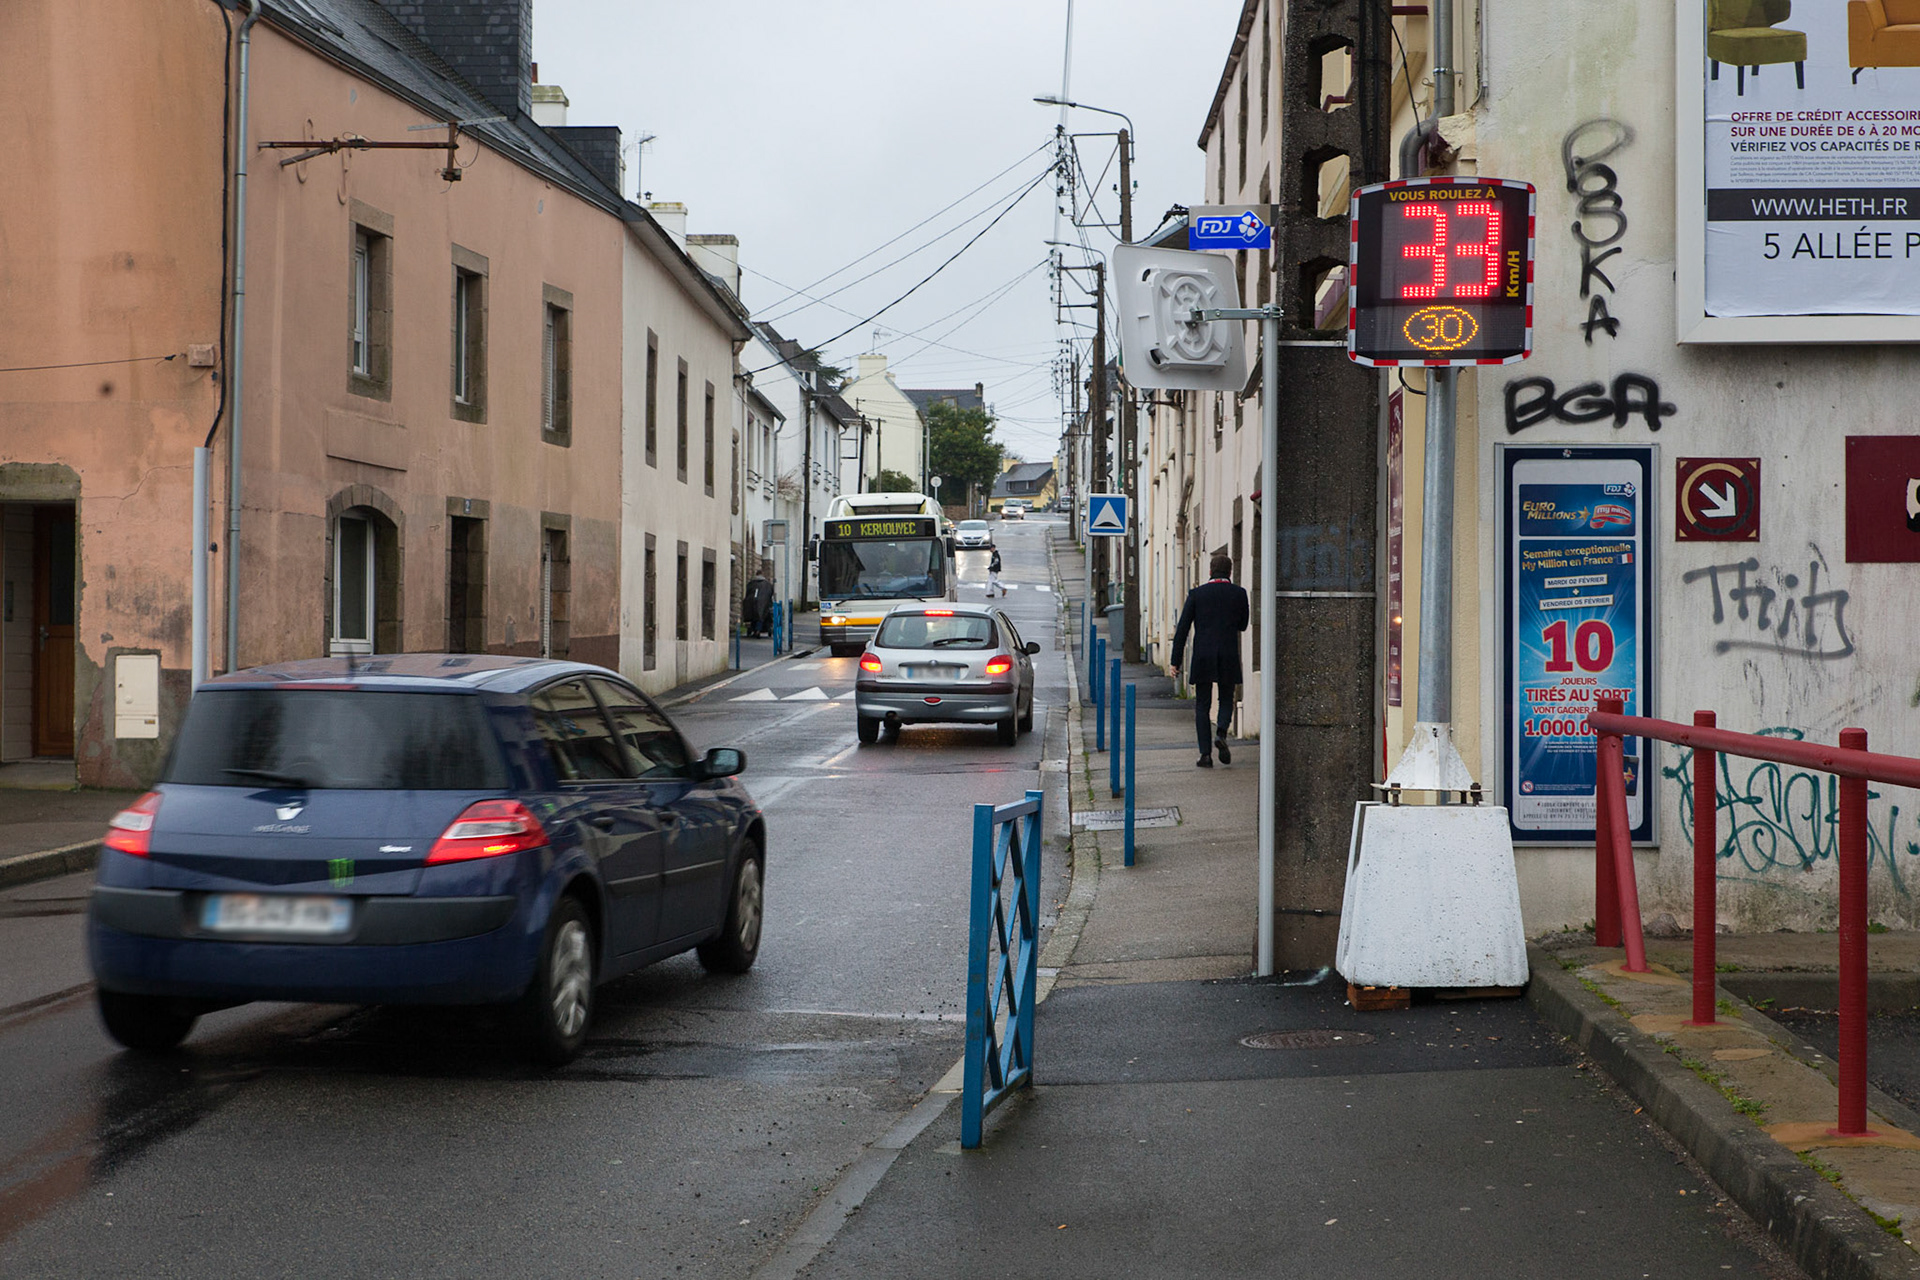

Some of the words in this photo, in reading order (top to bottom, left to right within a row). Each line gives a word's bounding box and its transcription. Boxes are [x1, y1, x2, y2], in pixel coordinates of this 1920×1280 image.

[1731, 112, 1772, 122] OFFRE
[1777, 111, 1794, 121] DE
[1798, 109, 1842, 121] CRÉDIT
[1731, 127, 1755, 137] SUR
[1760, 127, 1786, 136] UNE
[1791, 124, 1833, 136] DURÉE
[1838, 126, 1854, 136] DE
[1859, 126, 1865, 136] 6
[1869, 124, 1878, 136] À
[1882, 126, 1897, 136] 20
[1731, 140, 1786, 152] VÉRIFIEZ
[1790, 142, 1816, 151] VOS
[1821, 139, 1889, 151] CAPACITÉS
[1894, 141, 1910, 151] DE
[1389, 190, 1425, 201] VOUS
[1430, 189, 1481, 200] ROULEZ
[1486, 187, 1496, 199] À
[1752, 198, 1908, 216] WWW.HETH.FR
[1200, 220, 1232, 234] FDJ
[1763, 233, 1780, 259] 5
[1792, 226, 1892, 259] ALLÉE
[1402, 203, 1500, 298] 33
[1506, 250, 1520, 297] Km/H
[1421, 314, 1463, 342] 30
[1523, 501, 1555, 511] EURO
[1527, 511, 1576, 520] MILLIONS
[838, 524, 852, 536] 10
[860, 522, 916, 536] KERVOUYEC
[1523, 548, 1562, 559] Semaine
[1564, 544, 1631, 556] exceptionnelle
[1522, 561, 1536, 571] My
[1538, 558, 1568, 568] Million
[1583, 556, 1614, 565] France
[1578, 575, 1604, 584] FÉVRIER
[1584, 597, 1610, 605] FÉVRIER
[1542, 619, 1614, 673] 10
[1525, 687, 1566, 701] TIRÉS
[1569, 689, 1589, 701] AU
[1557, 706, 1589, 714] GAGNER
